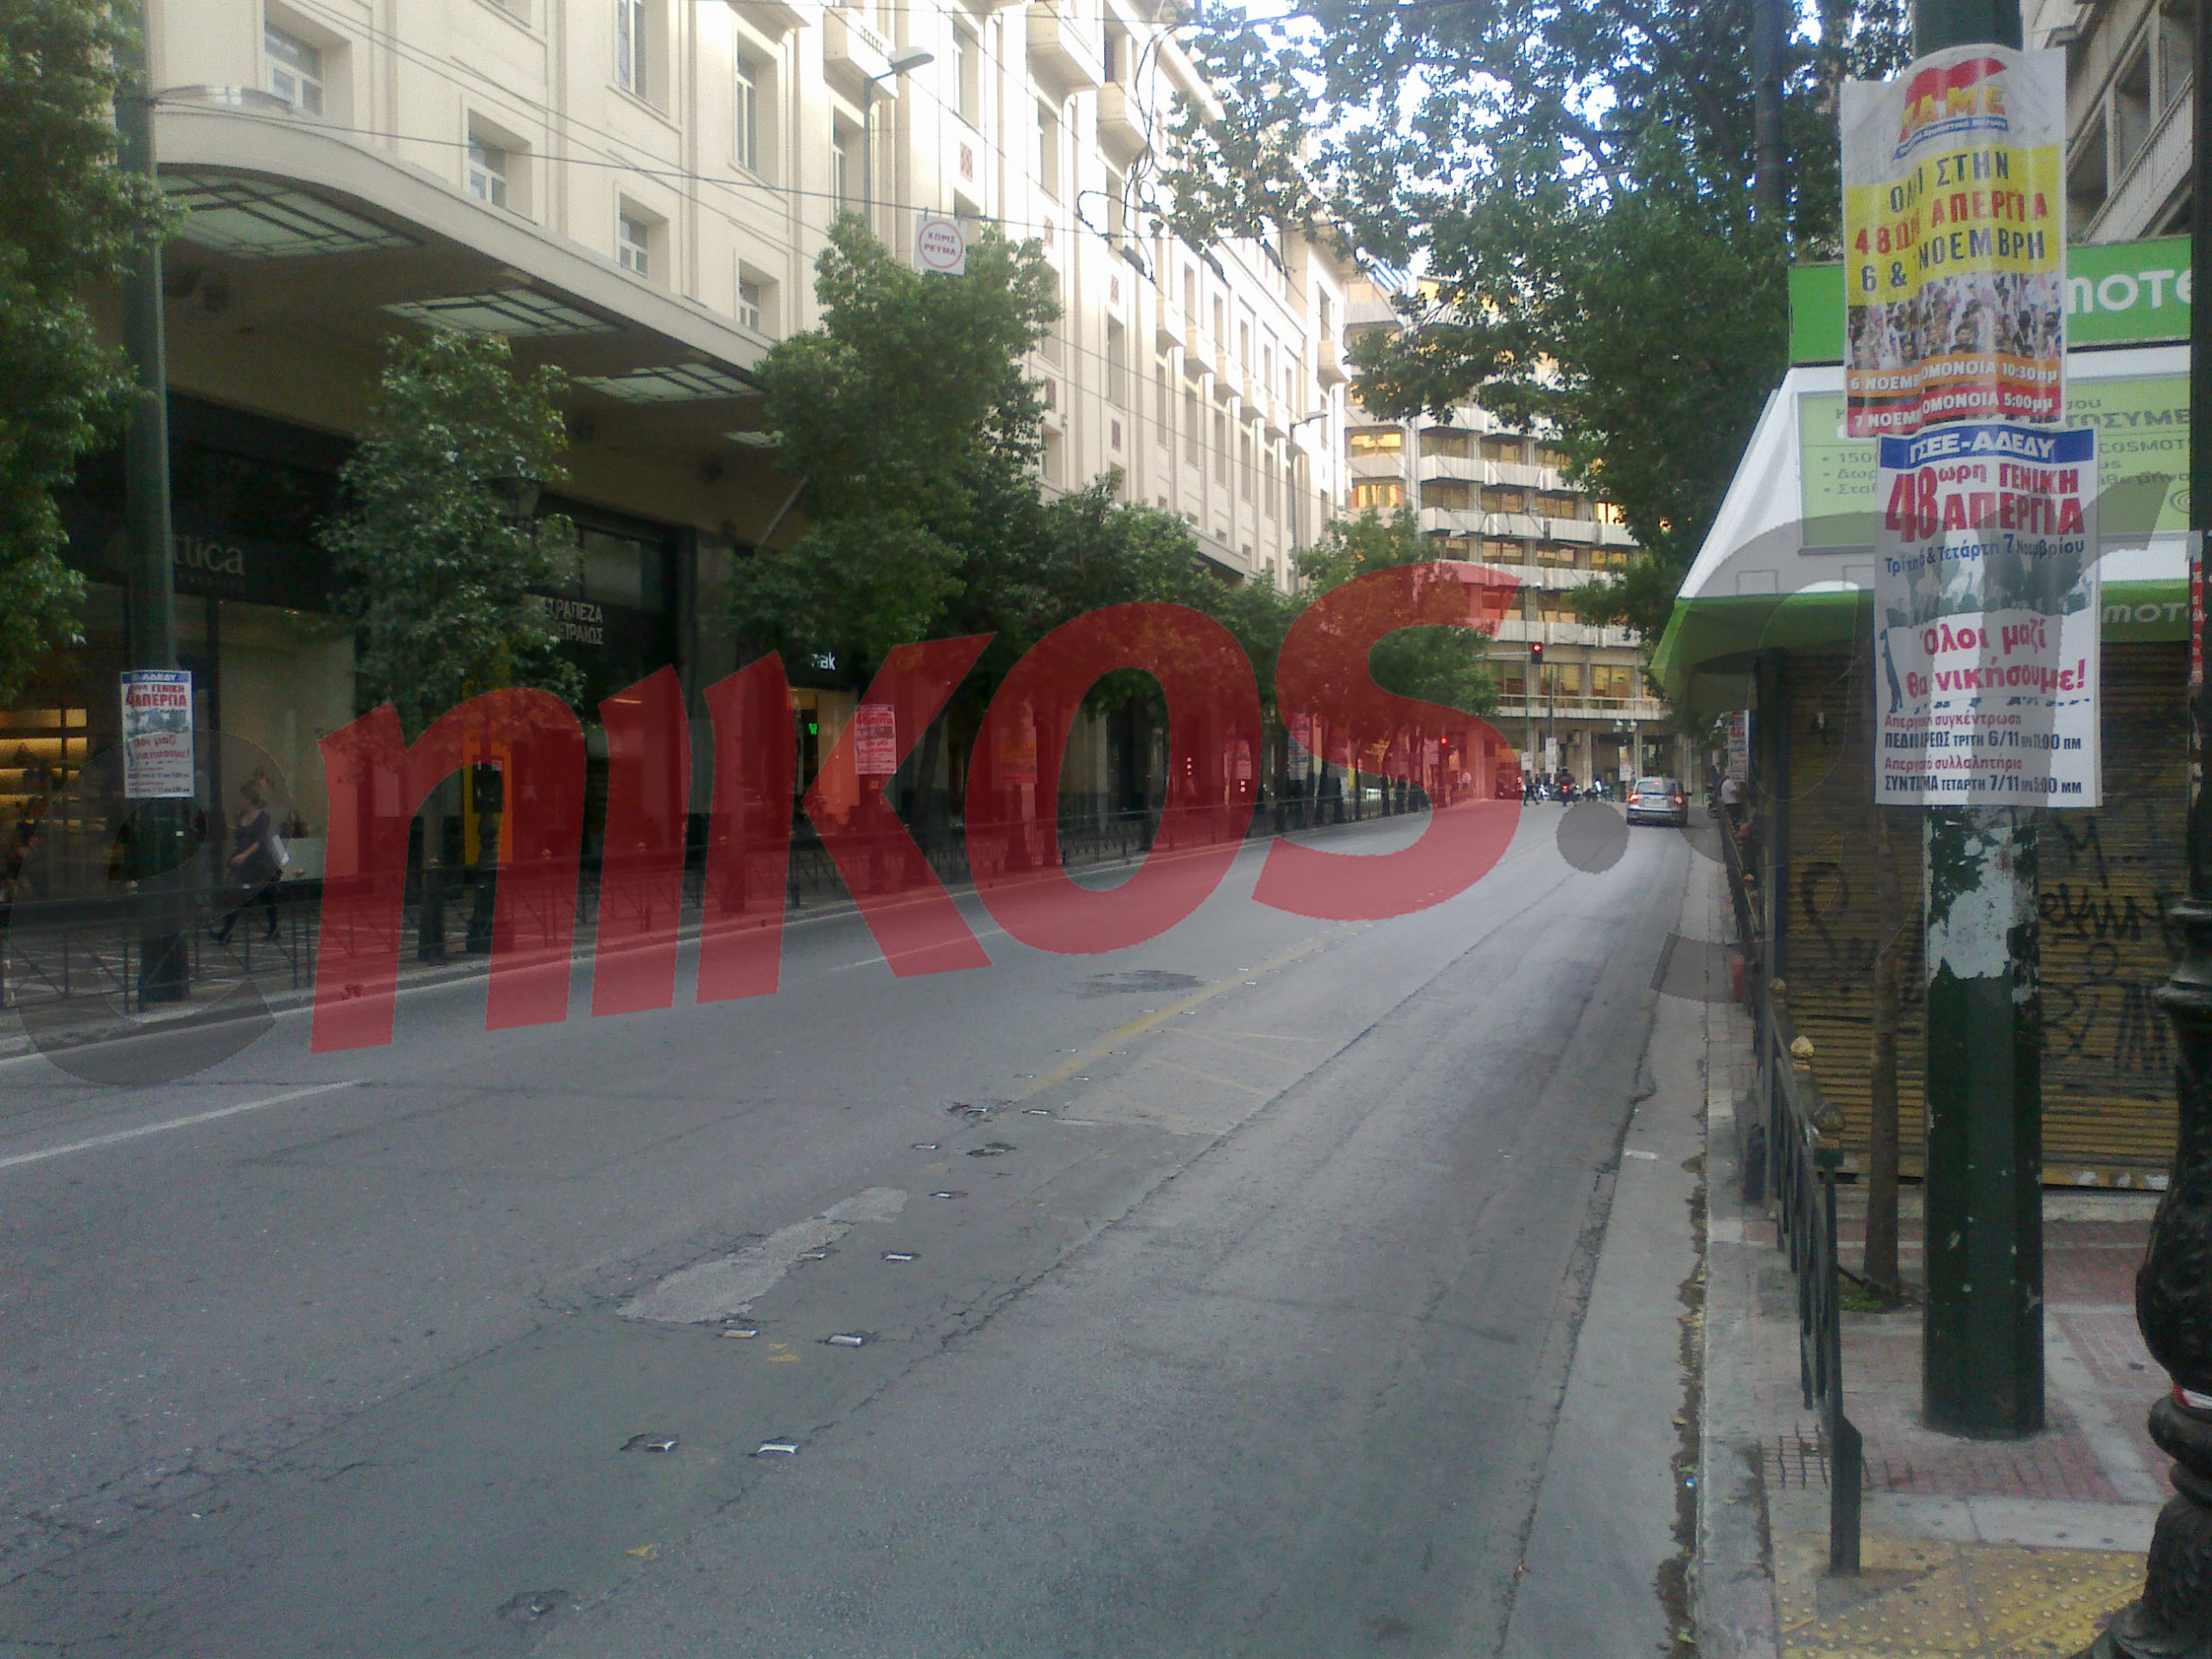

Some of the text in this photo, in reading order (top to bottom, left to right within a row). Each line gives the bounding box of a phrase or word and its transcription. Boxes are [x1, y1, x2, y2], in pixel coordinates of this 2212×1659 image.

[1936, 150, 2009, 187] ΣΤΗΝ
[1931, 190, 2048, 228] ΑΠΕΡΓΙΑ
[1861, 264, 1877, 292] 6
[1918, 228, 2044, 270] ΝΟΕΜΒΡΗ
[1922, 360, 1997, 380] ΟΜΟΝΟΙΑ
[1923, 392, 1999, 414] ΟΜΟΝΟΙΑ
[1839, 453, 1876, 463] 150
[1909, 432, 2056, 463] ΓΣΕΕ-ΑΔΕΔΥ
[2099, 439, 2186, 454] COSMOT
[1999, 463, 2079, 493] ΓΕΝΙΚΗ
[1942, 492, 2085, 535] ΑΠΕΡΓΙΑ
[1937, 539, 1999, 561] Τετάρτη
[2004, 533, 2014, 556] 7
[2001, 619, 2046, 655] μαζί
[1906, 656, 2086, 698] θα νικήσουμε!
[1936, 709, 2021, 729] συγκέντρωση
[1953, 734, 1985, 746] ΤΡΙΤΗ
[1988, 730, 2019, 747] 6/11
[1941, 779, 1986, 791] ΤΕΤΑΡΤΗ
[1989, 774, 2019, 791] 7/11
